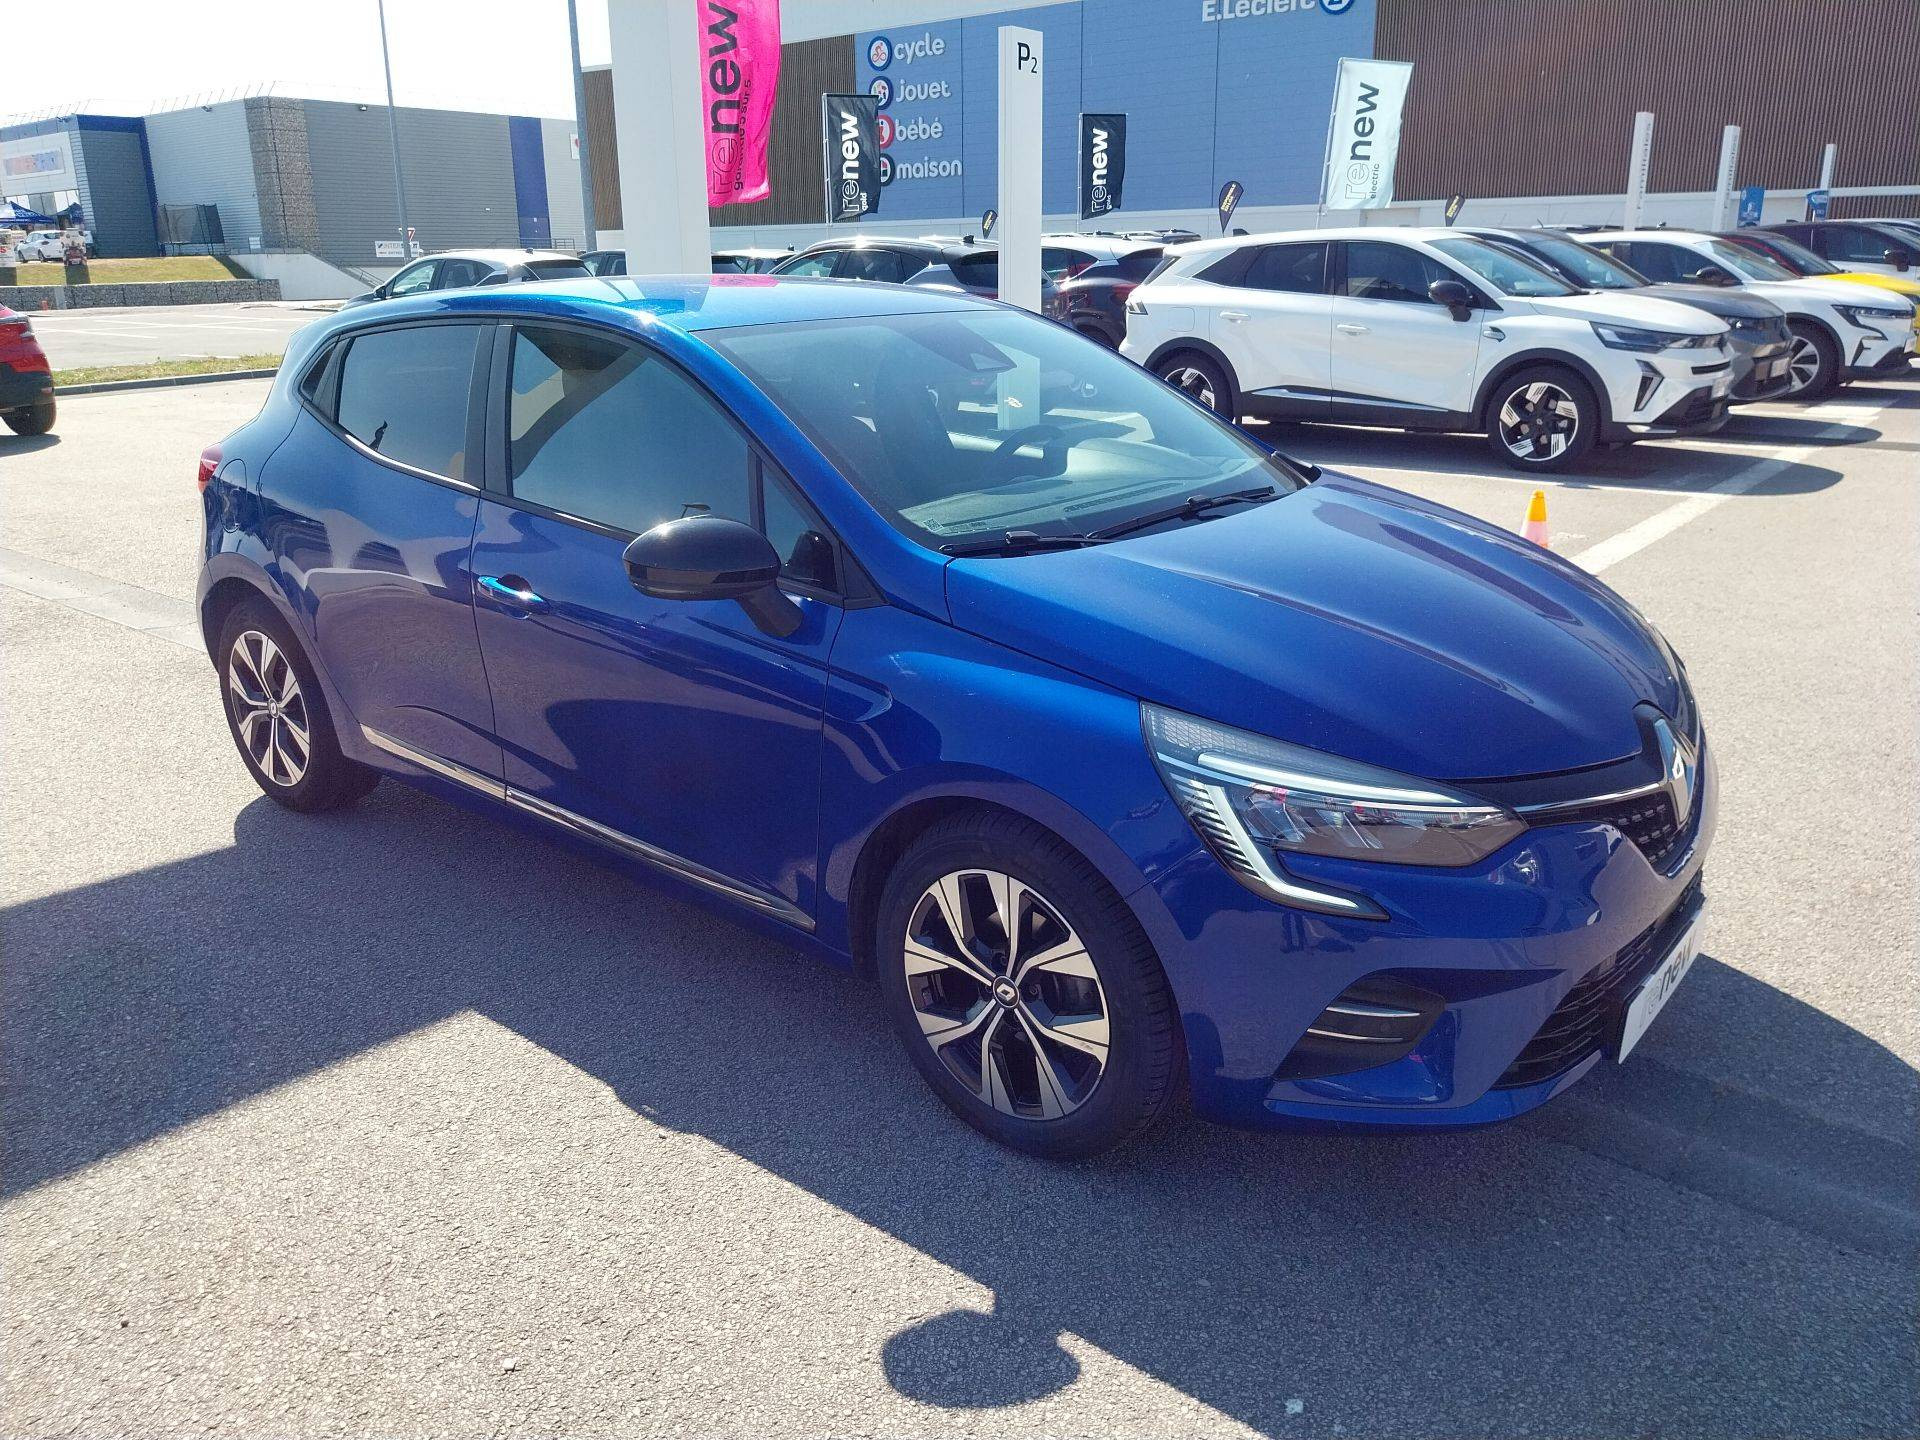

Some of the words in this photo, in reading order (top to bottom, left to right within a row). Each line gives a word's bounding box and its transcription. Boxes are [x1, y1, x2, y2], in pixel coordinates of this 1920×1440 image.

[894, 32, 945, 64] cycle
[708, 2, 741, 194] renew
[896, 79, 951, 102] jouet
[895, 117, 943, 141] bébé
[1345, 82, 1380, 199] renew
[841, 111, 860, 212] renew
[896, 156, 962, 179] maison
[1092, 128, 1108, 212] renew
[1370, 163, 1380, 199] electric
[860, 193, 868, 211] gold
